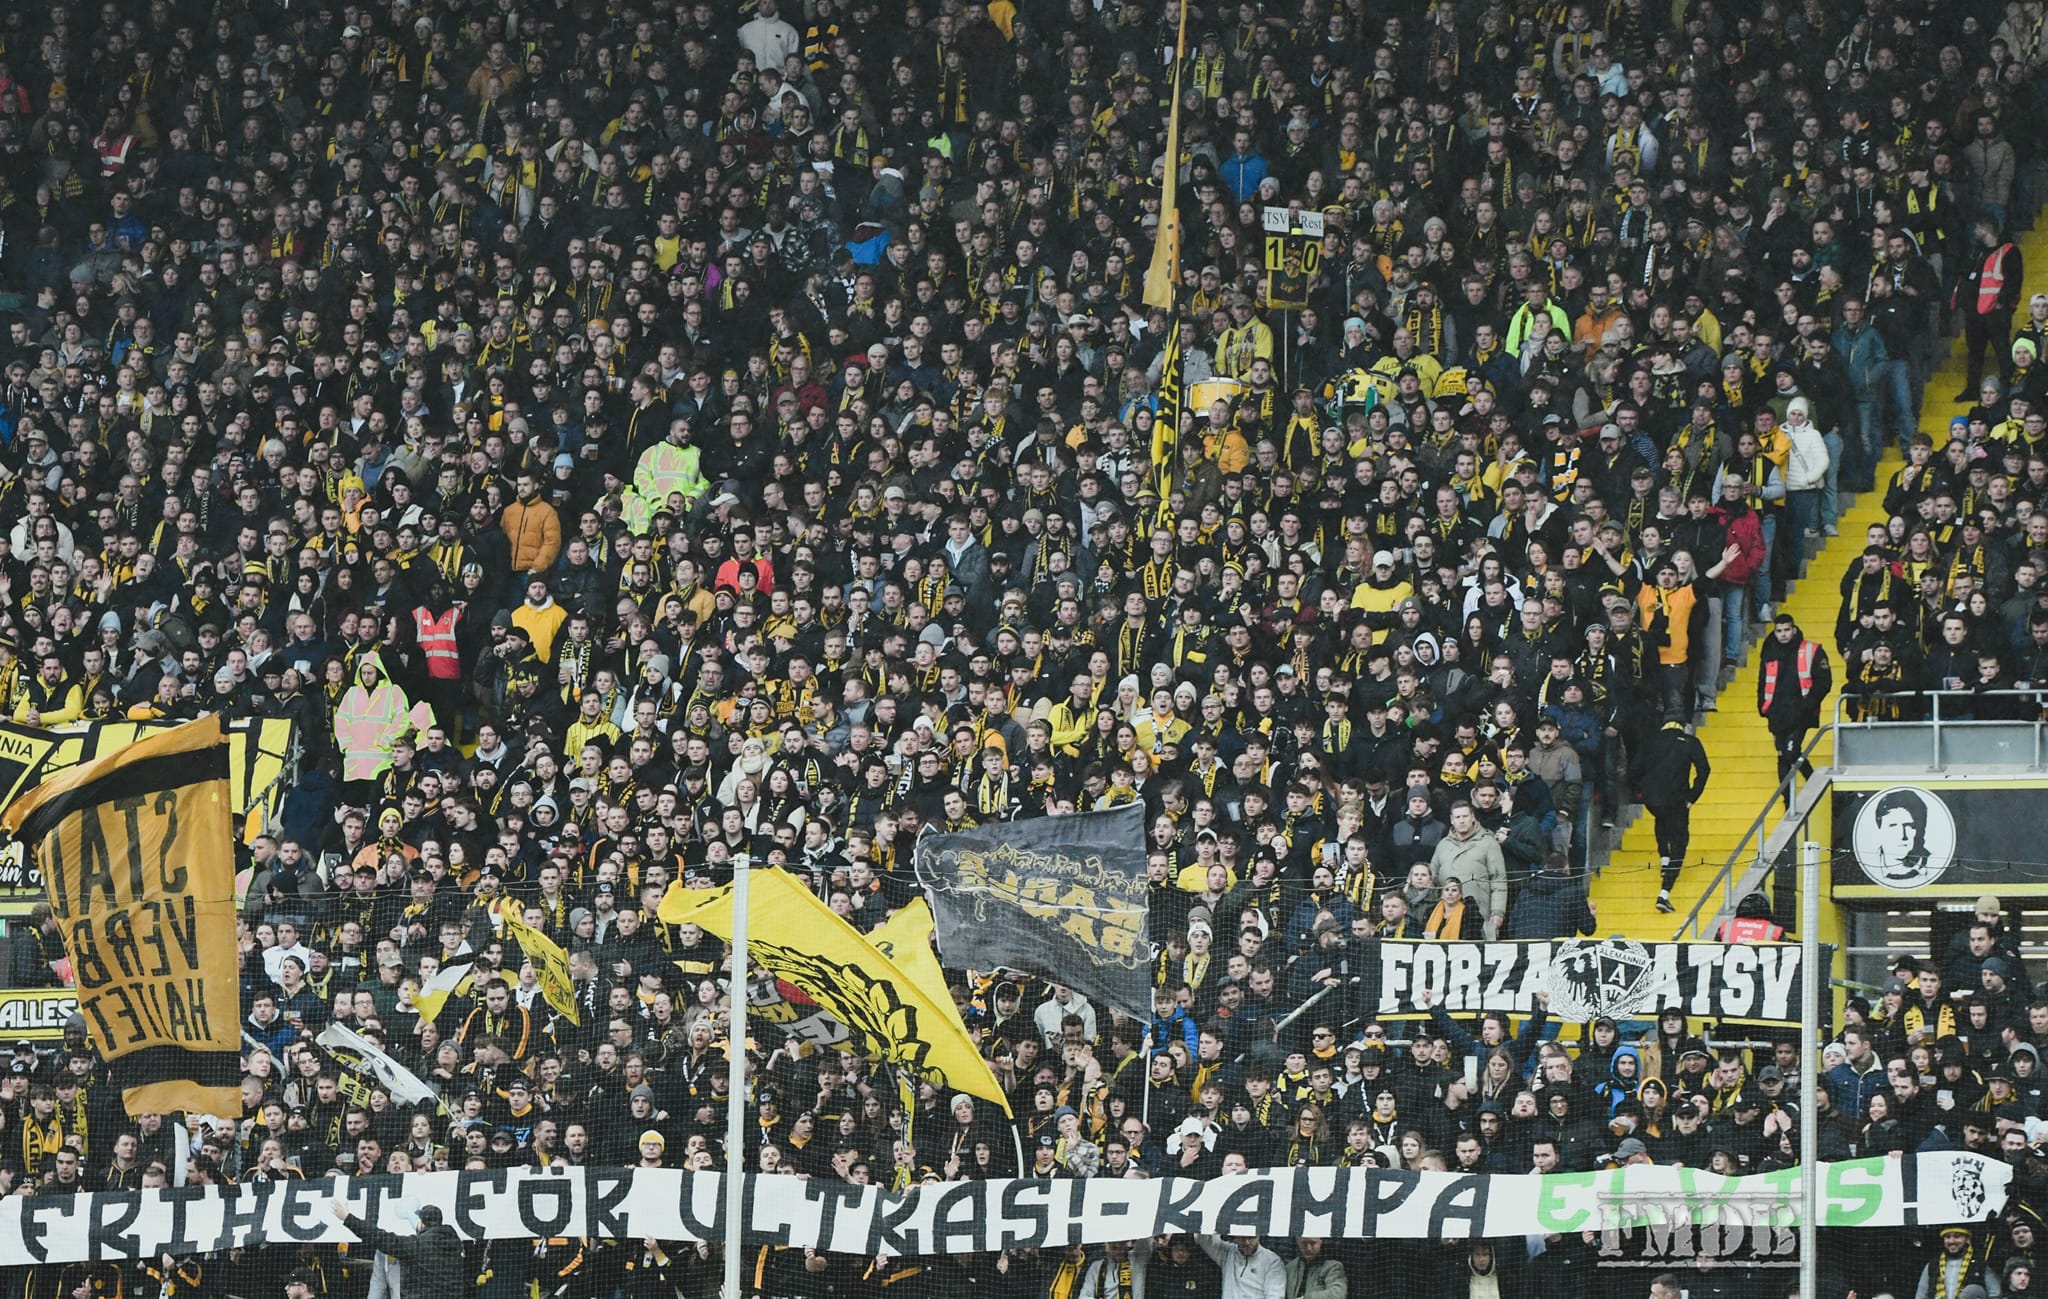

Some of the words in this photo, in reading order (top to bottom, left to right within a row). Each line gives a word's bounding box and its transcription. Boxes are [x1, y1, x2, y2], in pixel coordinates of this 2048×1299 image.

[1265, 211, 1288, 226] TSV
[1301, 214, 1323, 230] Rest
[1268, 239, 1279, 268] 1
[1303, 243, 1319, 272] 0
[1600, 946, 1647, 966] ALEMANNIA
[1378, 943, 1553, 1014] FORZA
[1647, 943, 1801, 1020] ATSV
[1608, 963, 1626, 987] A
[0, 999, 78, 1029] ALLES
[20, 1174, 403, 1263] FRIHET
[455, 1166, 634, 1239] FÖR
